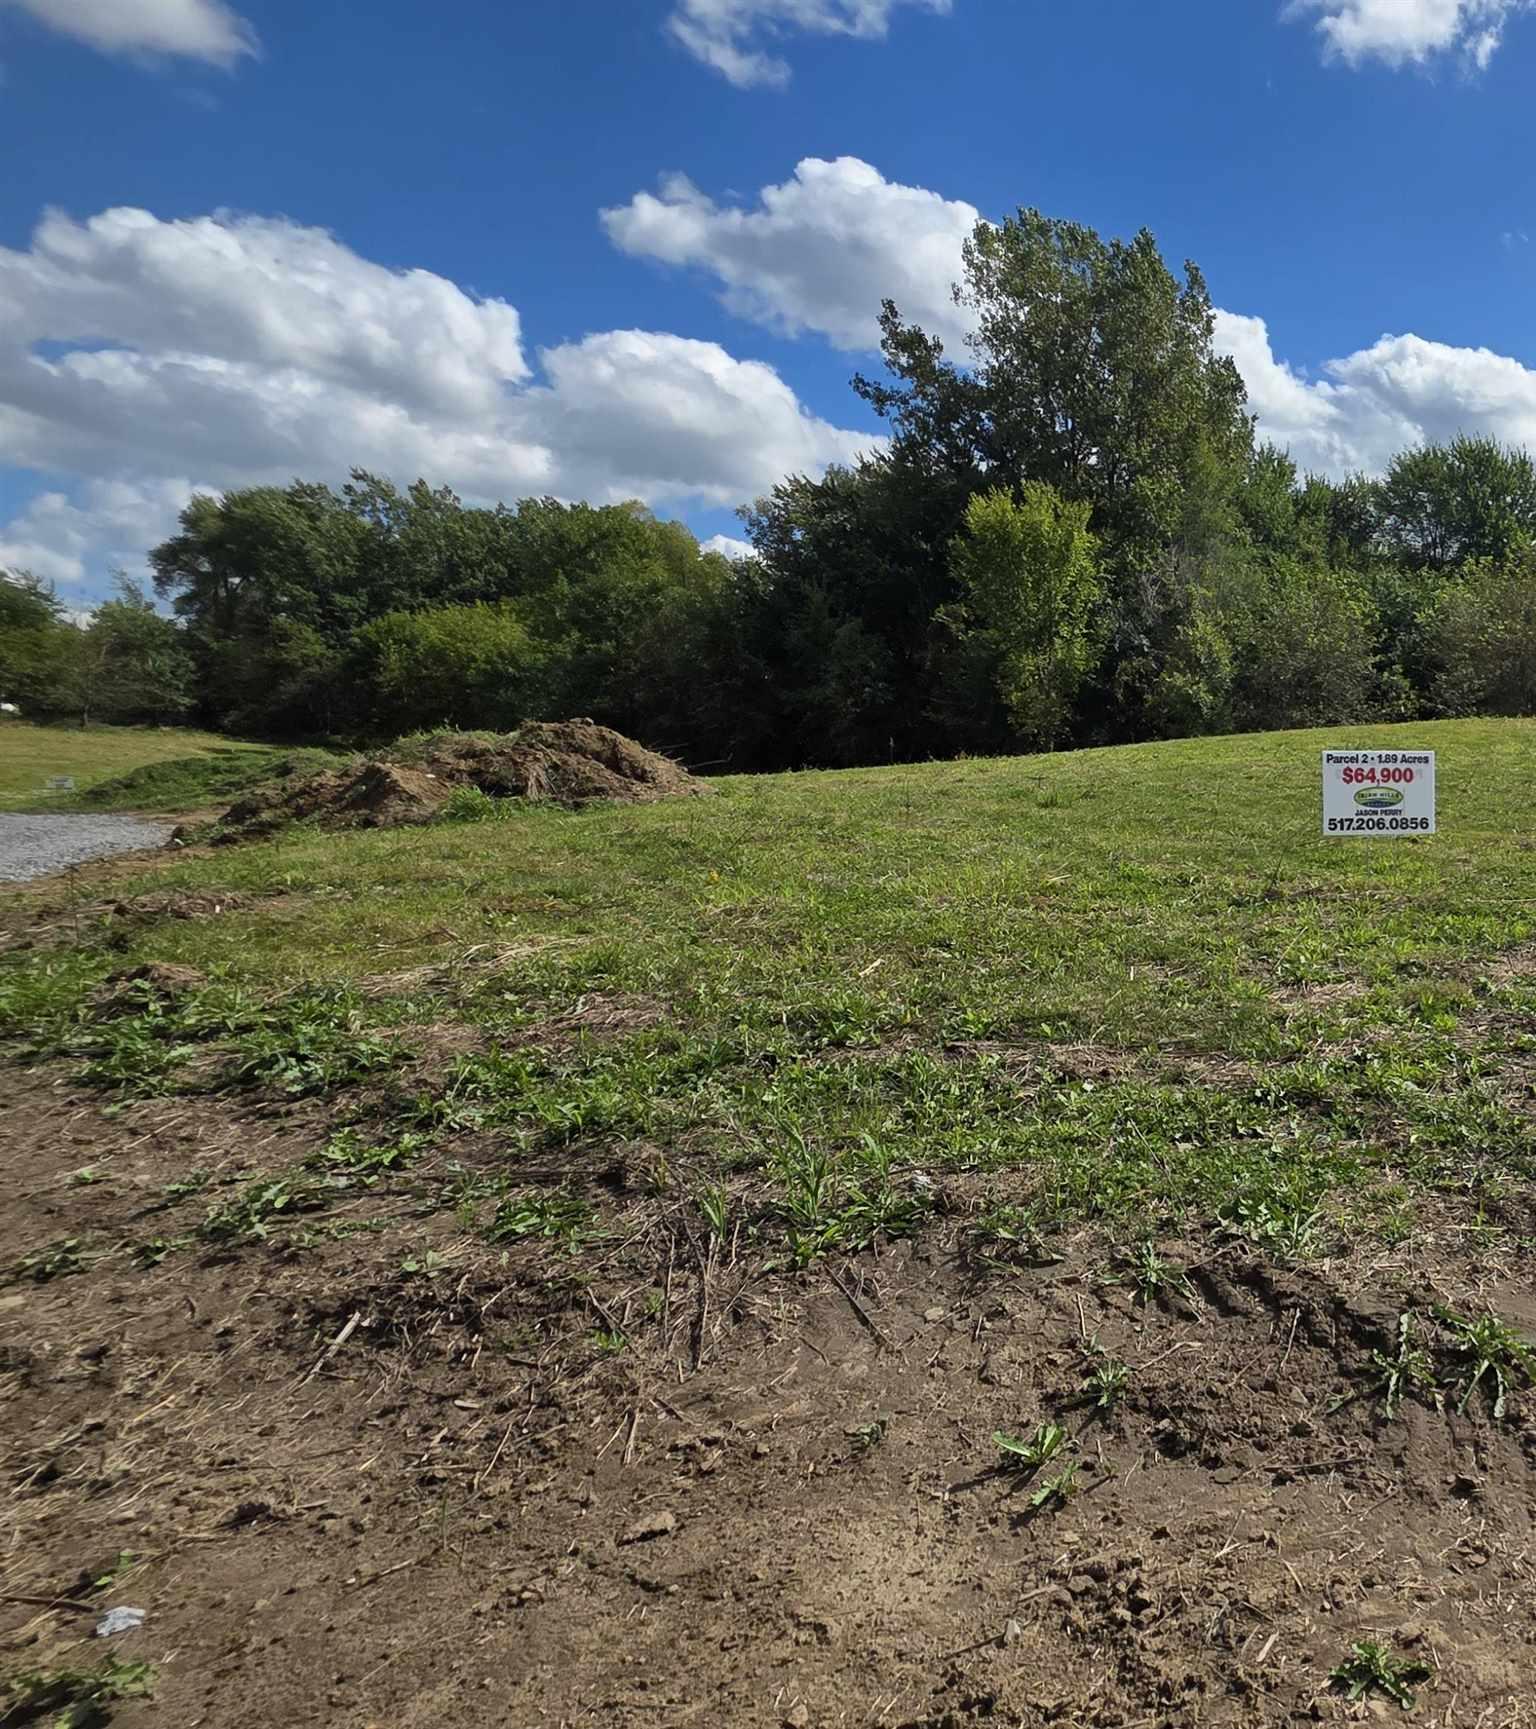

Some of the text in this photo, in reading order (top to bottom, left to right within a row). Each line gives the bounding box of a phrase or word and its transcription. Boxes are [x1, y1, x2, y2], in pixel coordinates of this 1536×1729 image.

[1326, 754, 1429, 764] Parcel 2 1.89 Acres
[1342, 766, 1414, 786] $64,900
[1328, 817, 1430, 832] 517.206.0856
